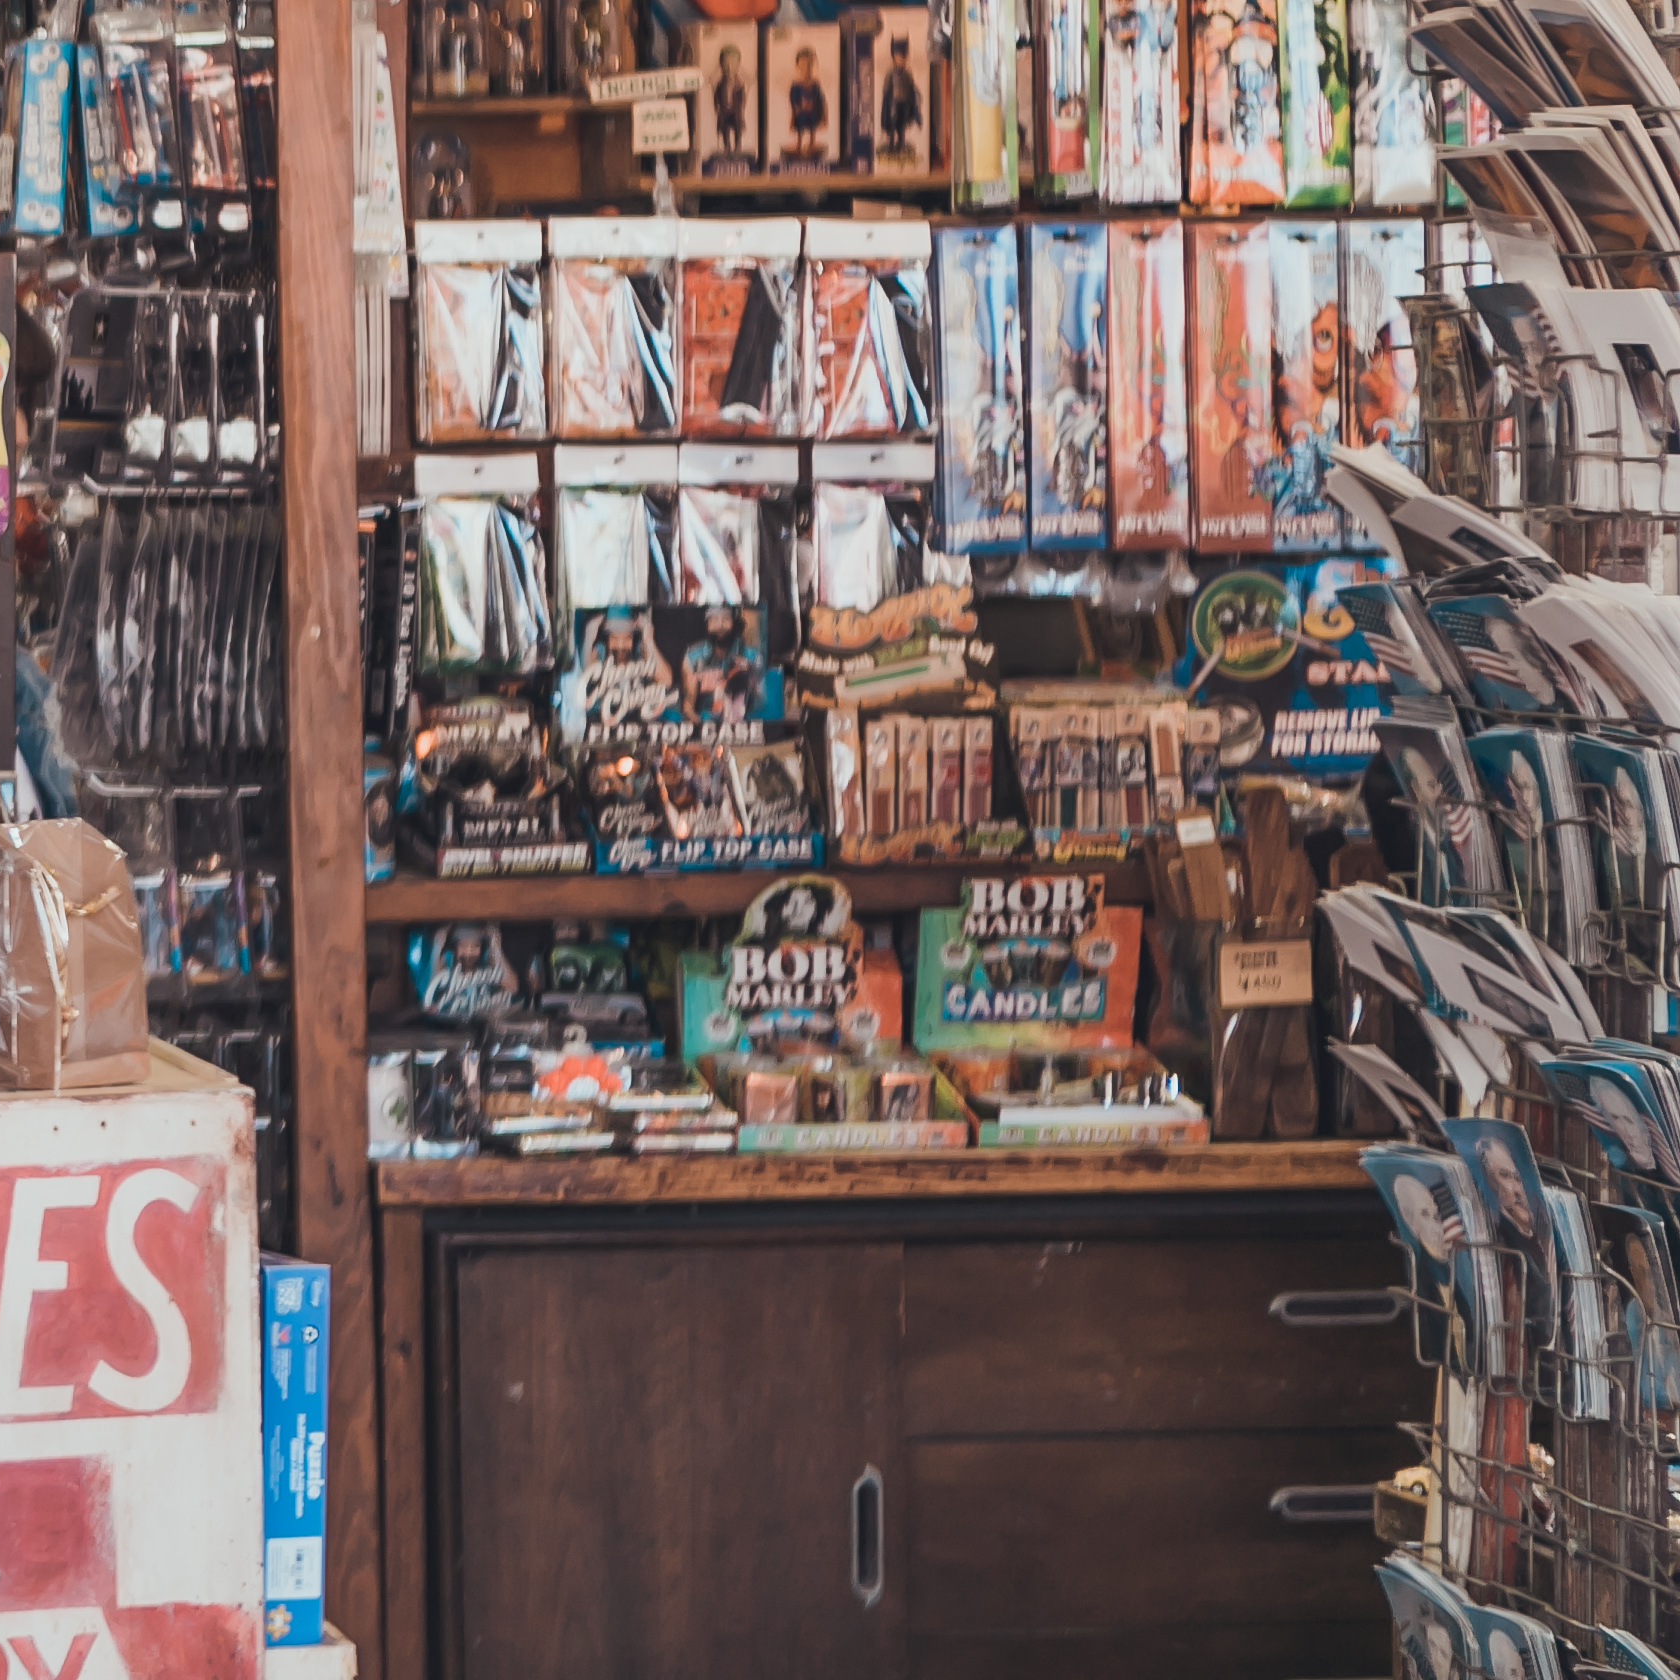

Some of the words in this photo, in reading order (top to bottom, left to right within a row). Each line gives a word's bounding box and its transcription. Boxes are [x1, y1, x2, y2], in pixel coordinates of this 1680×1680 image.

[646, 720, 694, 746] TOP
[660, 840, 708, 863] FLIP
[713, 840, 752, 863] TOP
[972, 876, 1087, 915] BOB
[731, 946, 847, 984] BOB
[726, 982, 851, 1008] MARLEY
[944, 980, 1104, 1022] CANDLES
[305, 1430, 327, 1501] Puzzle
